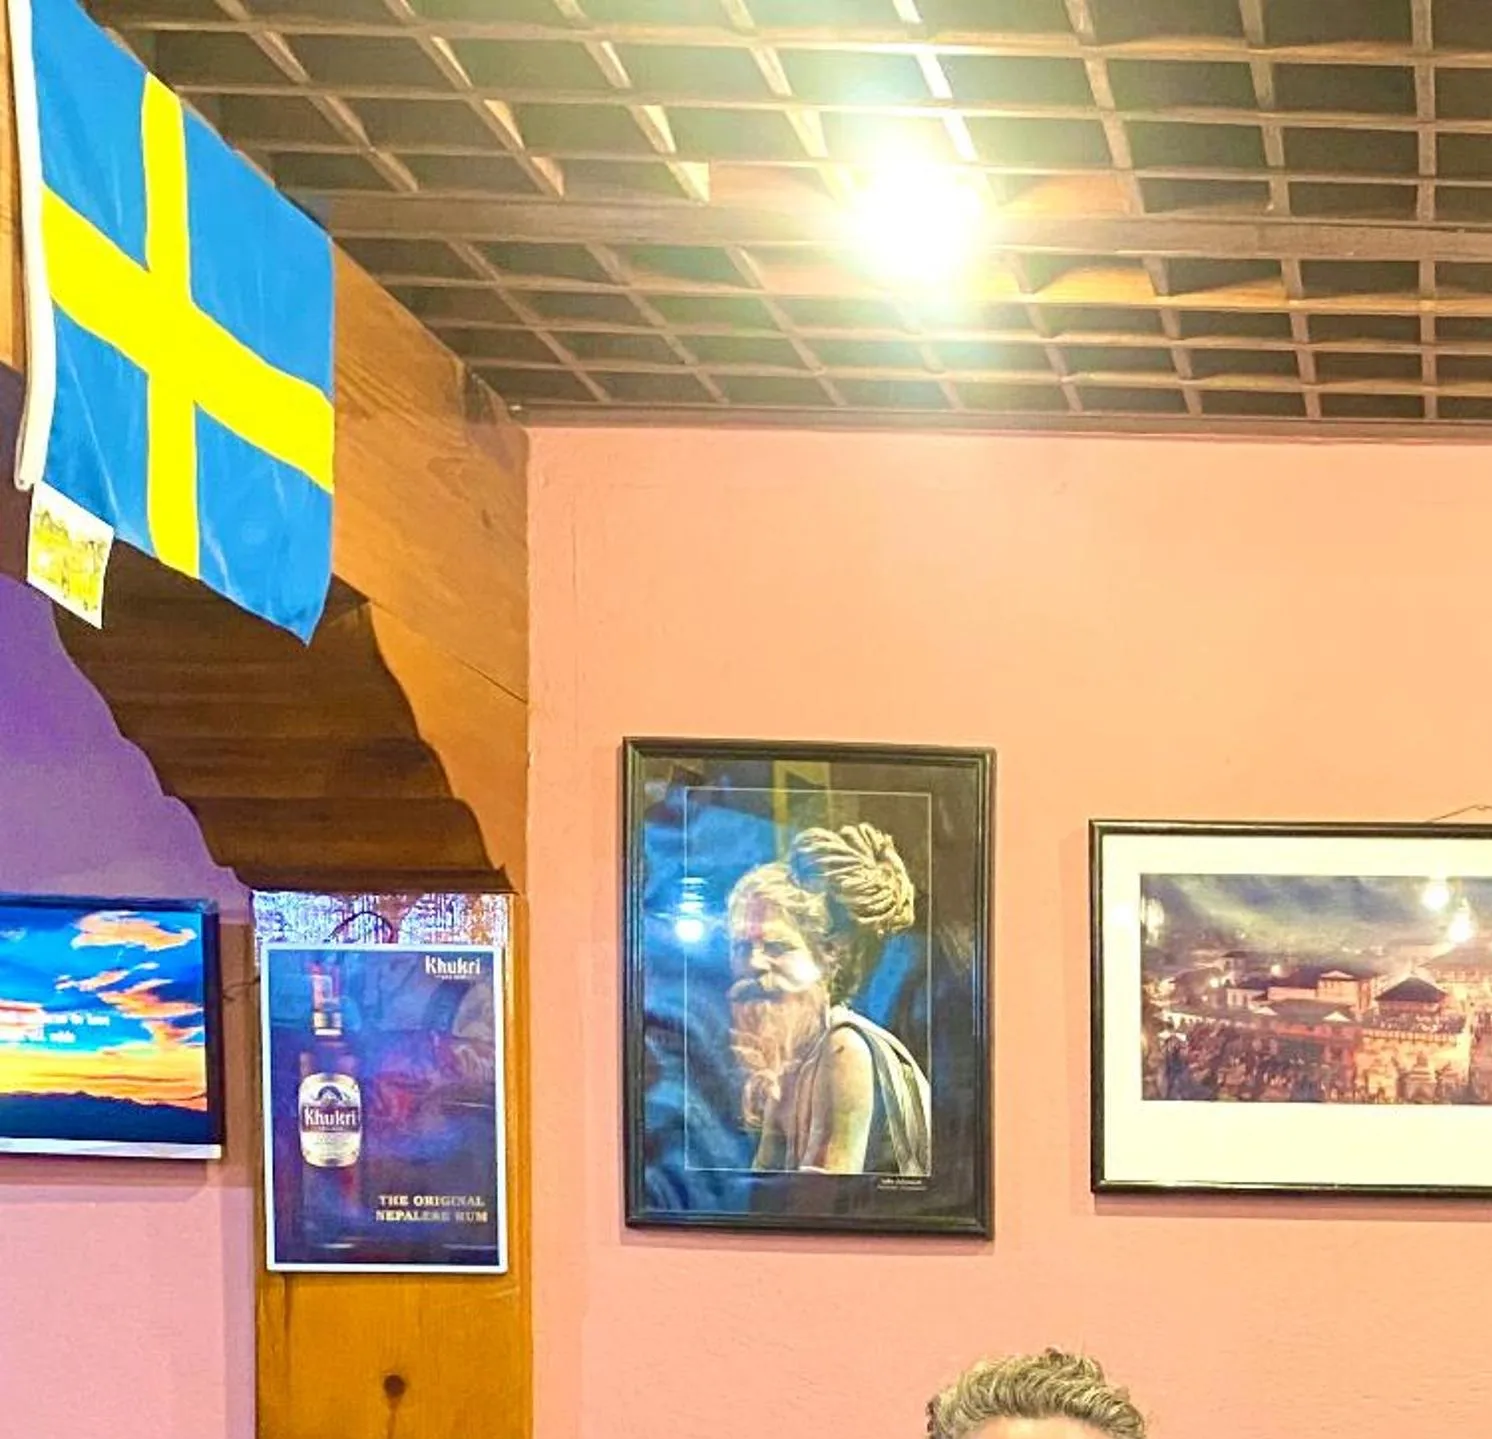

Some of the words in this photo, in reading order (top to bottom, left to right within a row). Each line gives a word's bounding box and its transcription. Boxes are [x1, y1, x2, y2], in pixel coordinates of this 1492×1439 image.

[425, 954, 481, 975] Khukri
[304, 1106, 357, 1127] Khukri
[378, 1194, 409, 1207] THE
[413, 1194, 486, 1207] ORIGINAL
[455, 1210, 488, 1223] RUM
